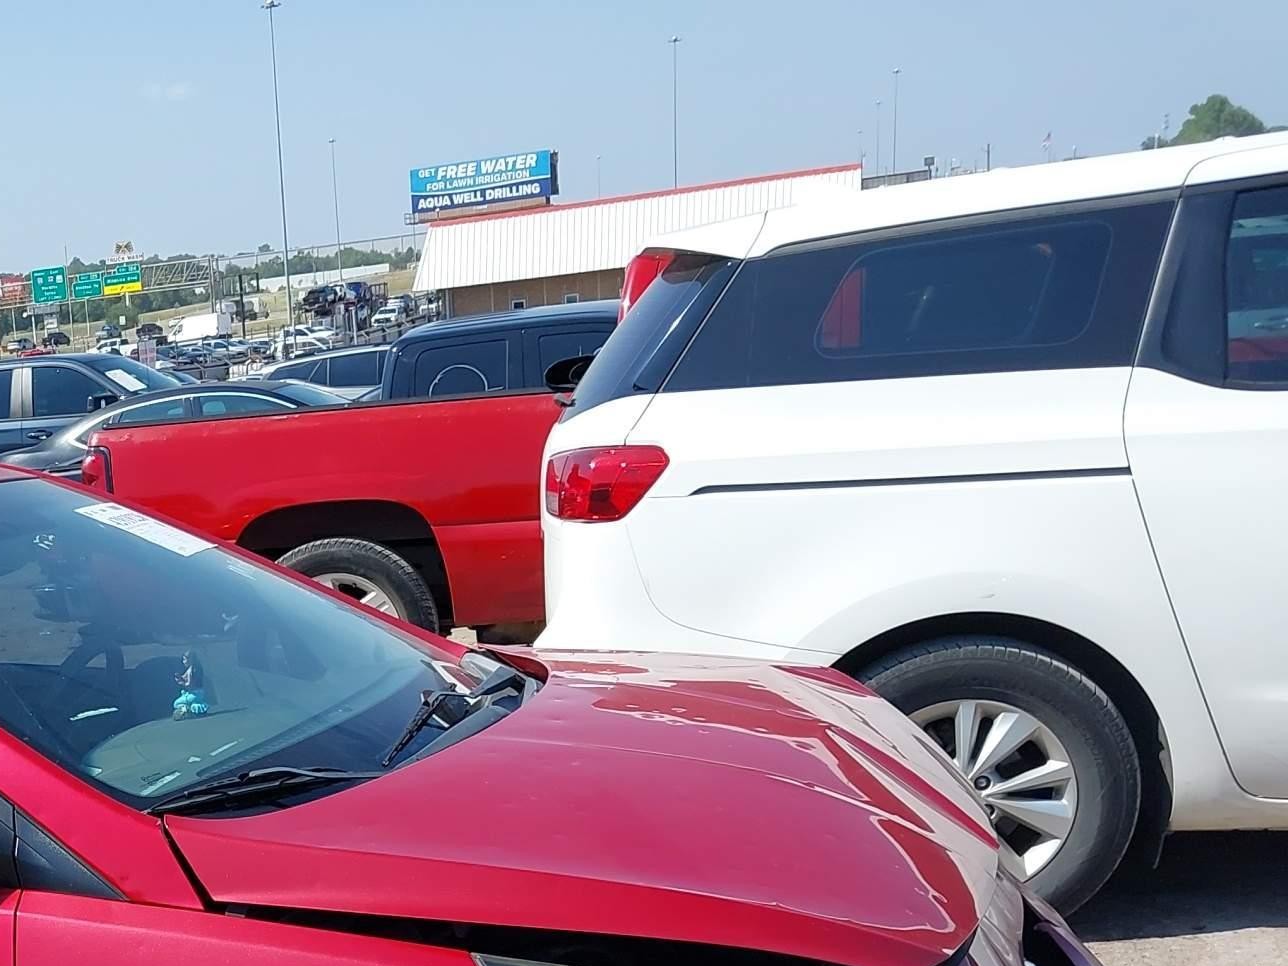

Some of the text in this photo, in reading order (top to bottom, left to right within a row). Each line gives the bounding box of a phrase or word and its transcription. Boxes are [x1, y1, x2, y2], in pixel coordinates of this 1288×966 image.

[419, 154, 537, 180] GET FREE WATER
[426, 169, 530, 192] FOR LAWN IRRIGATION
[418, 183, 541, 209] AQUA WELL DRILLING
